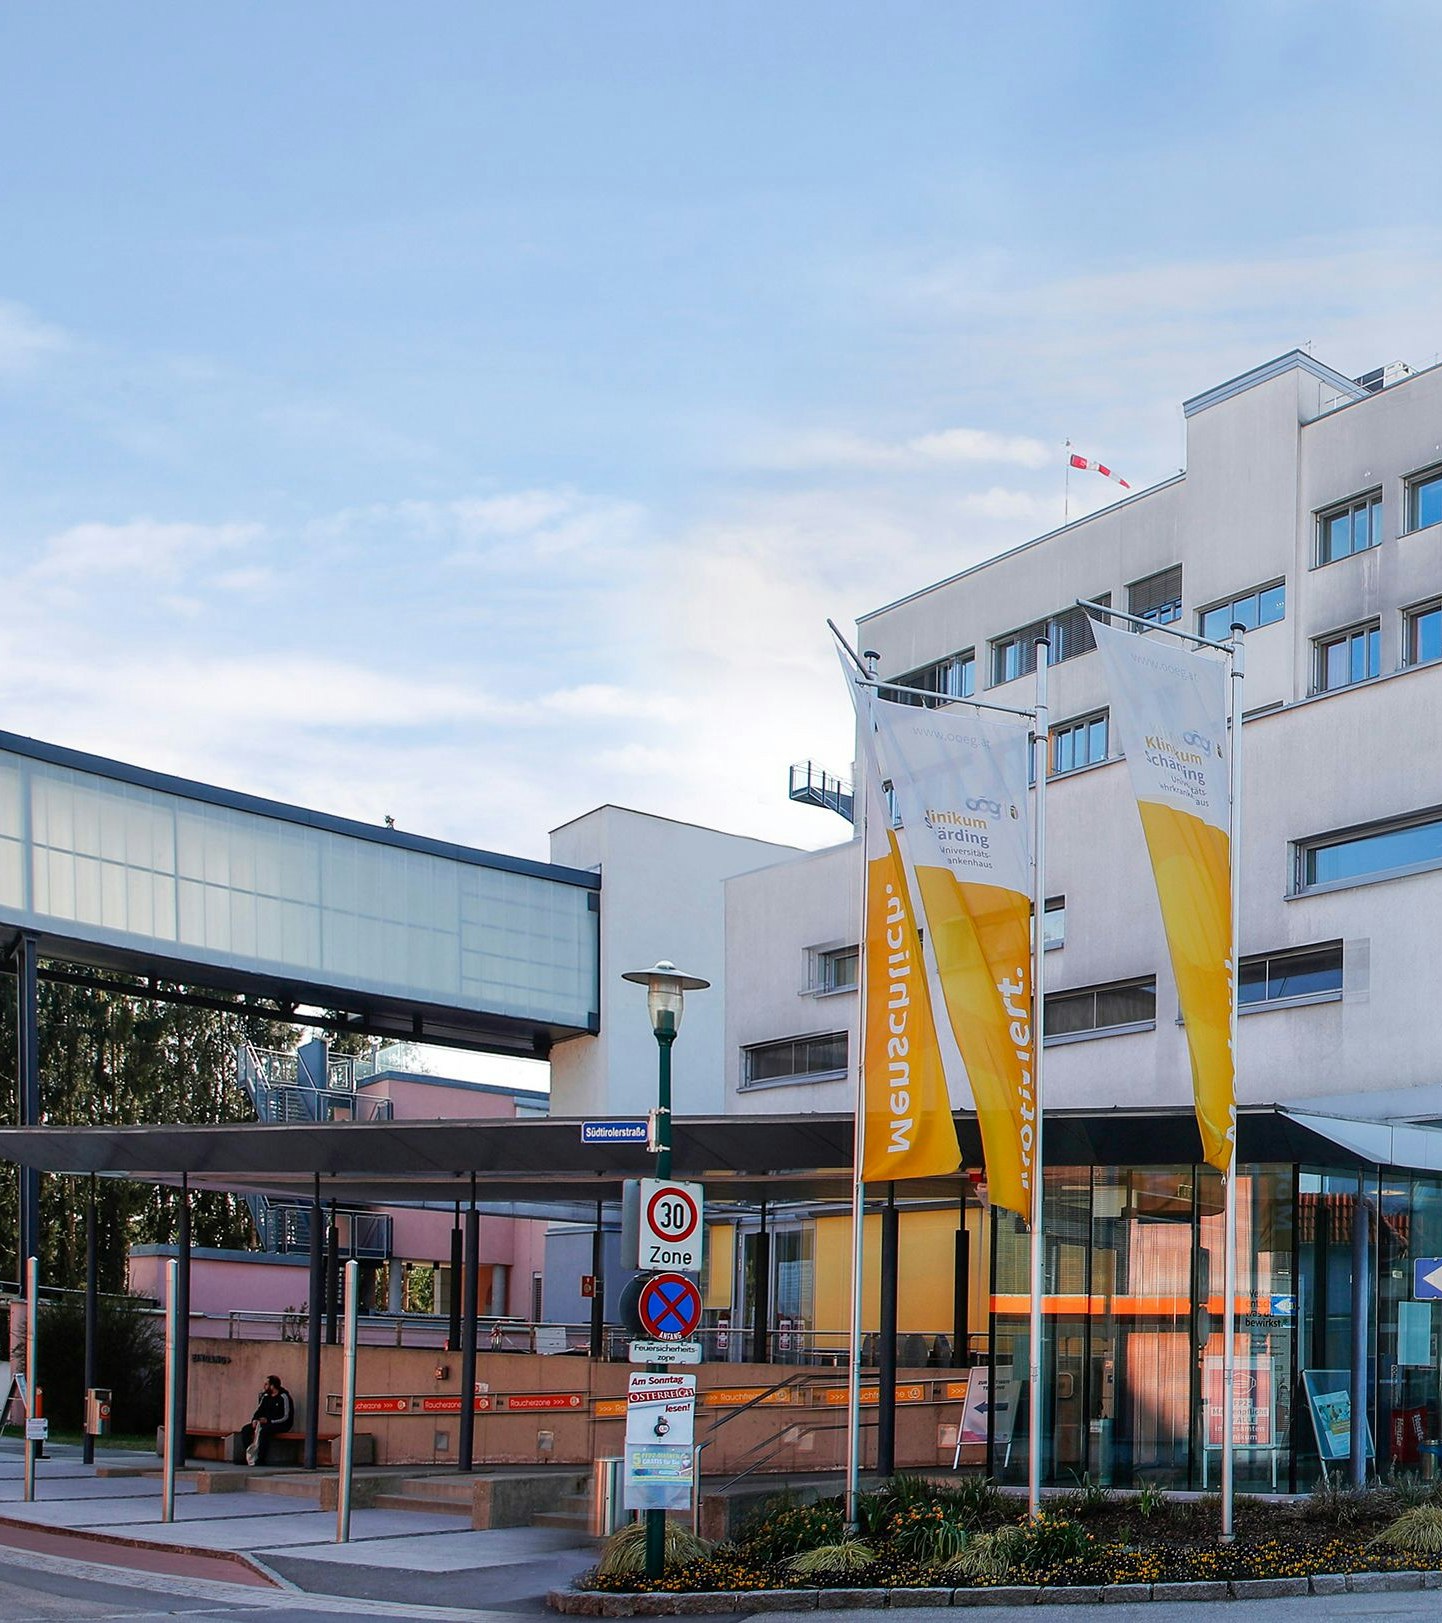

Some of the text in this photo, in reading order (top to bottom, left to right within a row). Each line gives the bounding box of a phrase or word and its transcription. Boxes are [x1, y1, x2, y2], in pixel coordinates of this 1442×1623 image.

[1145, 735, 1202, 765] Klinkum
[1145, 750, 1205, 786] Schäring
[926, 810, 987, 829] linikum
[925, 817, 989, 849] Särding
[586, 1127, 646, 1137] Südtirolerstraße
[660, 1202, 685, 1229] 30
[650, 1246, 692, 1265] Zone
[659, 1331, 682, 1341] ANFANG
[634, 1344, 697, 1353] Feuersicherheits-
[648, 1376, 684, 1385] Sonntag
[510, 1399, 550, 1407] Raucherzone
[665, 1404, 690, 1412] lesen!
